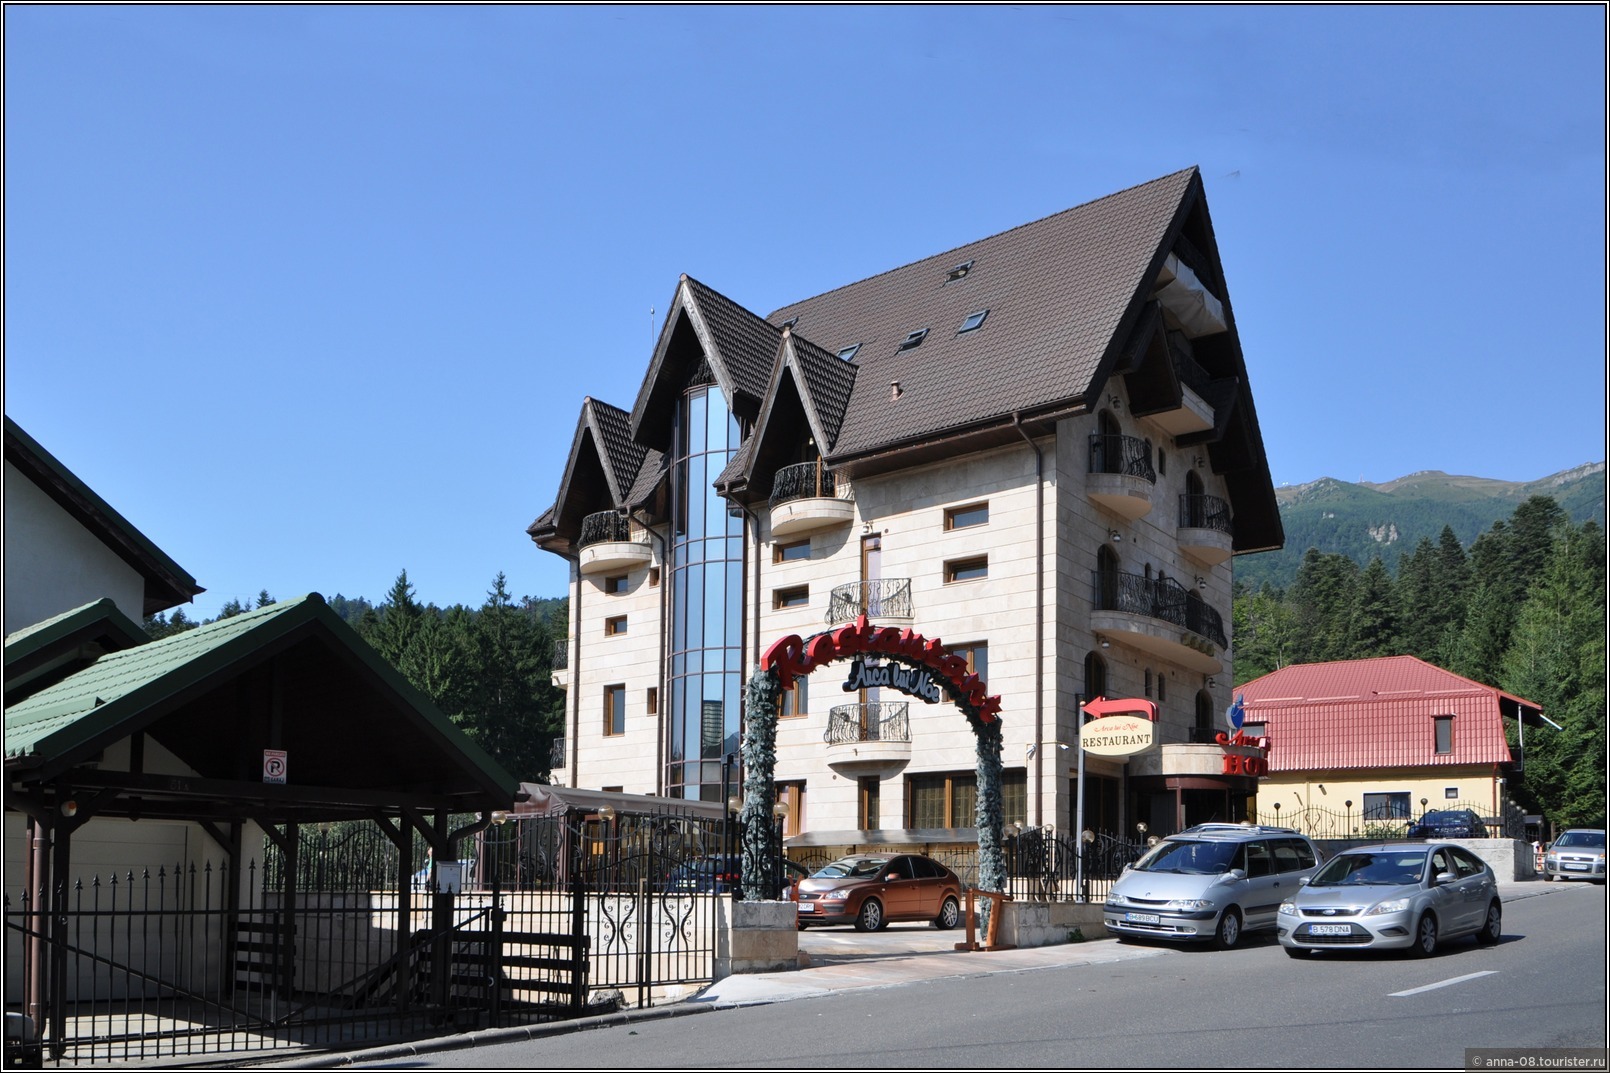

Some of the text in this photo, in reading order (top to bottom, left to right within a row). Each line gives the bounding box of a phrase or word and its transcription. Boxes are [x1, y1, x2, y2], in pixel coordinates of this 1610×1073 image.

[761, 614, 1002, 723] Restaurant
[850, 662, 940, 703] Arca lui Noe
[1082, 733, 1151, 748] RESTAURANT
